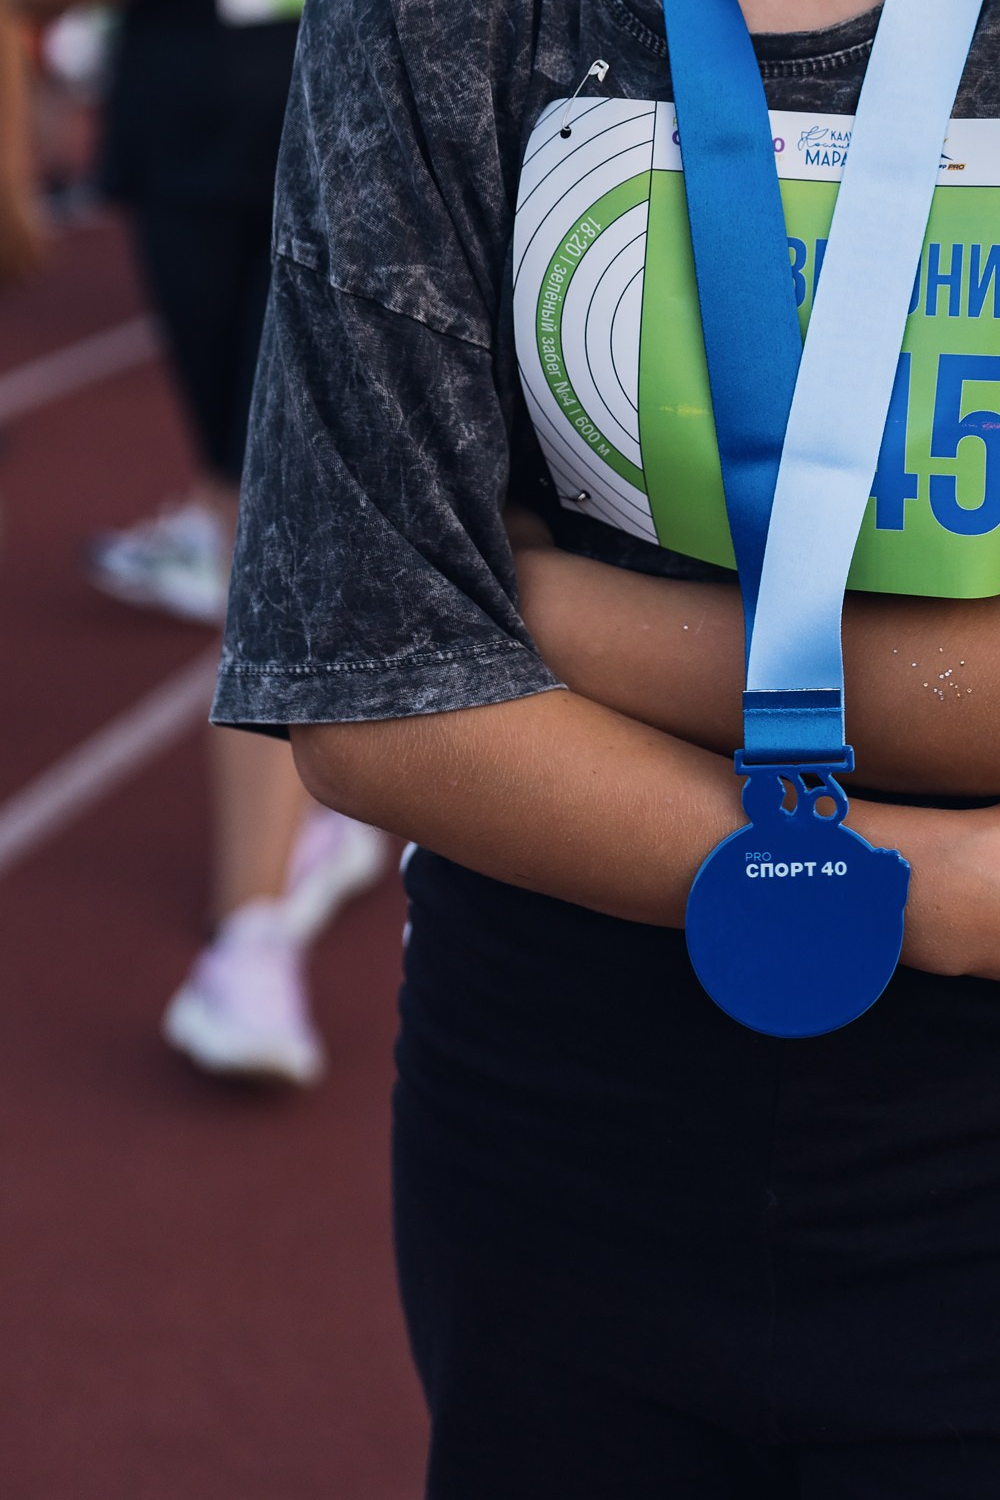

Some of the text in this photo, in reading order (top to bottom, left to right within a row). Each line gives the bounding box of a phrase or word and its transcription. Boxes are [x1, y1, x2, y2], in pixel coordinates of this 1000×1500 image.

[565, 216, 601, 258] 18:20
[541, 263, 567, 332] зелёный
[541, 337, 562, 377] забег
[575, 416, 600, 443] 600
[745, 852, 772, 861] PRO
[745, 861, 848, 878] СПОРТ 40
